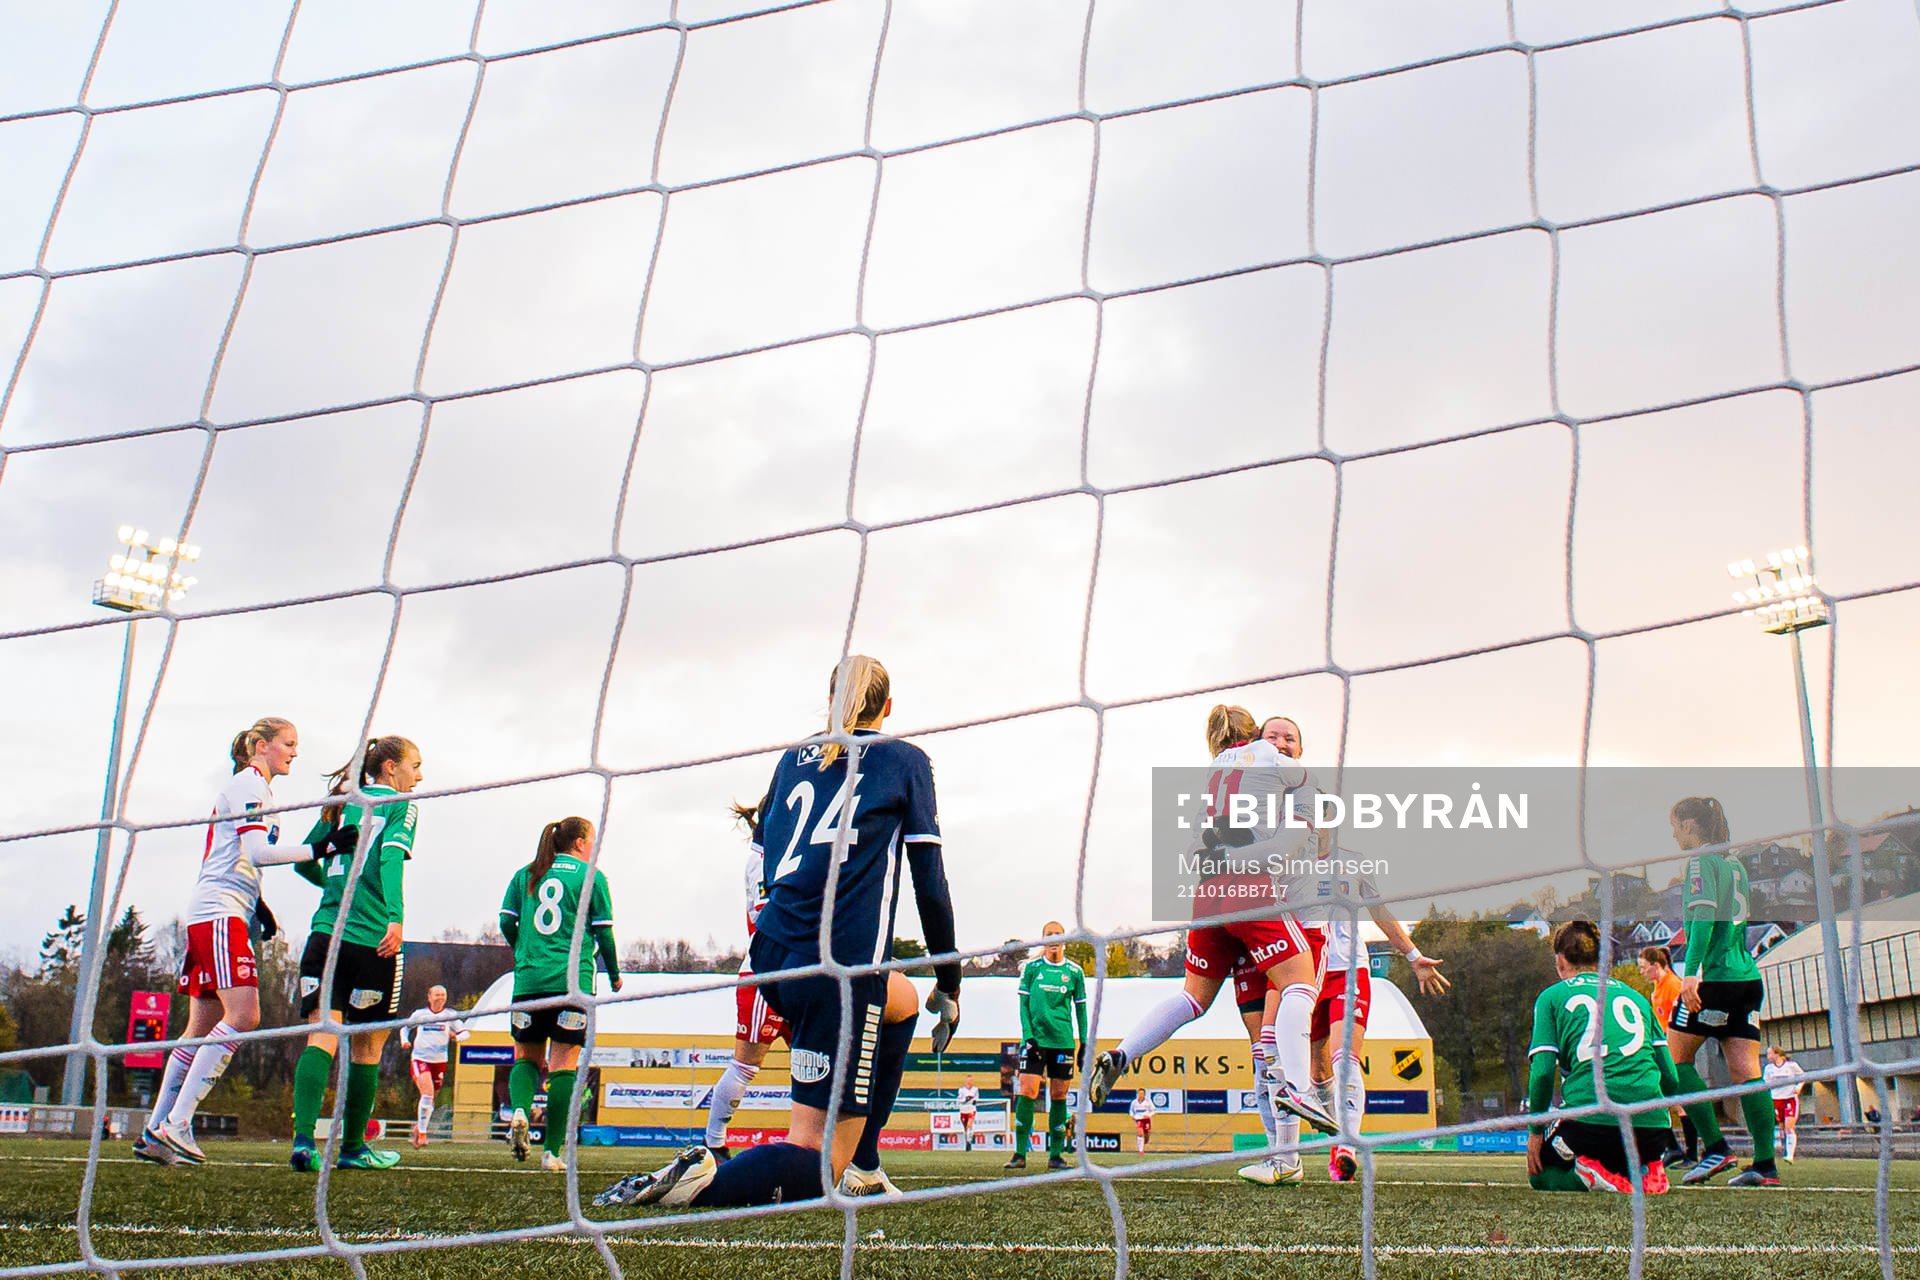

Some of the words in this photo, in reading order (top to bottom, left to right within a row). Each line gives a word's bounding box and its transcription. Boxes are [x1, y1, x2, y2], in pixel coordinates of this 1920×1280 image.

[774, 773, 865, 881] 24
[534, 878, 564, 935] 8
[1250, 939, 1289, 964] ht.no
[1565, 994, 1645, 1063] 29
[880, 1136, 917, 1145] equinor
